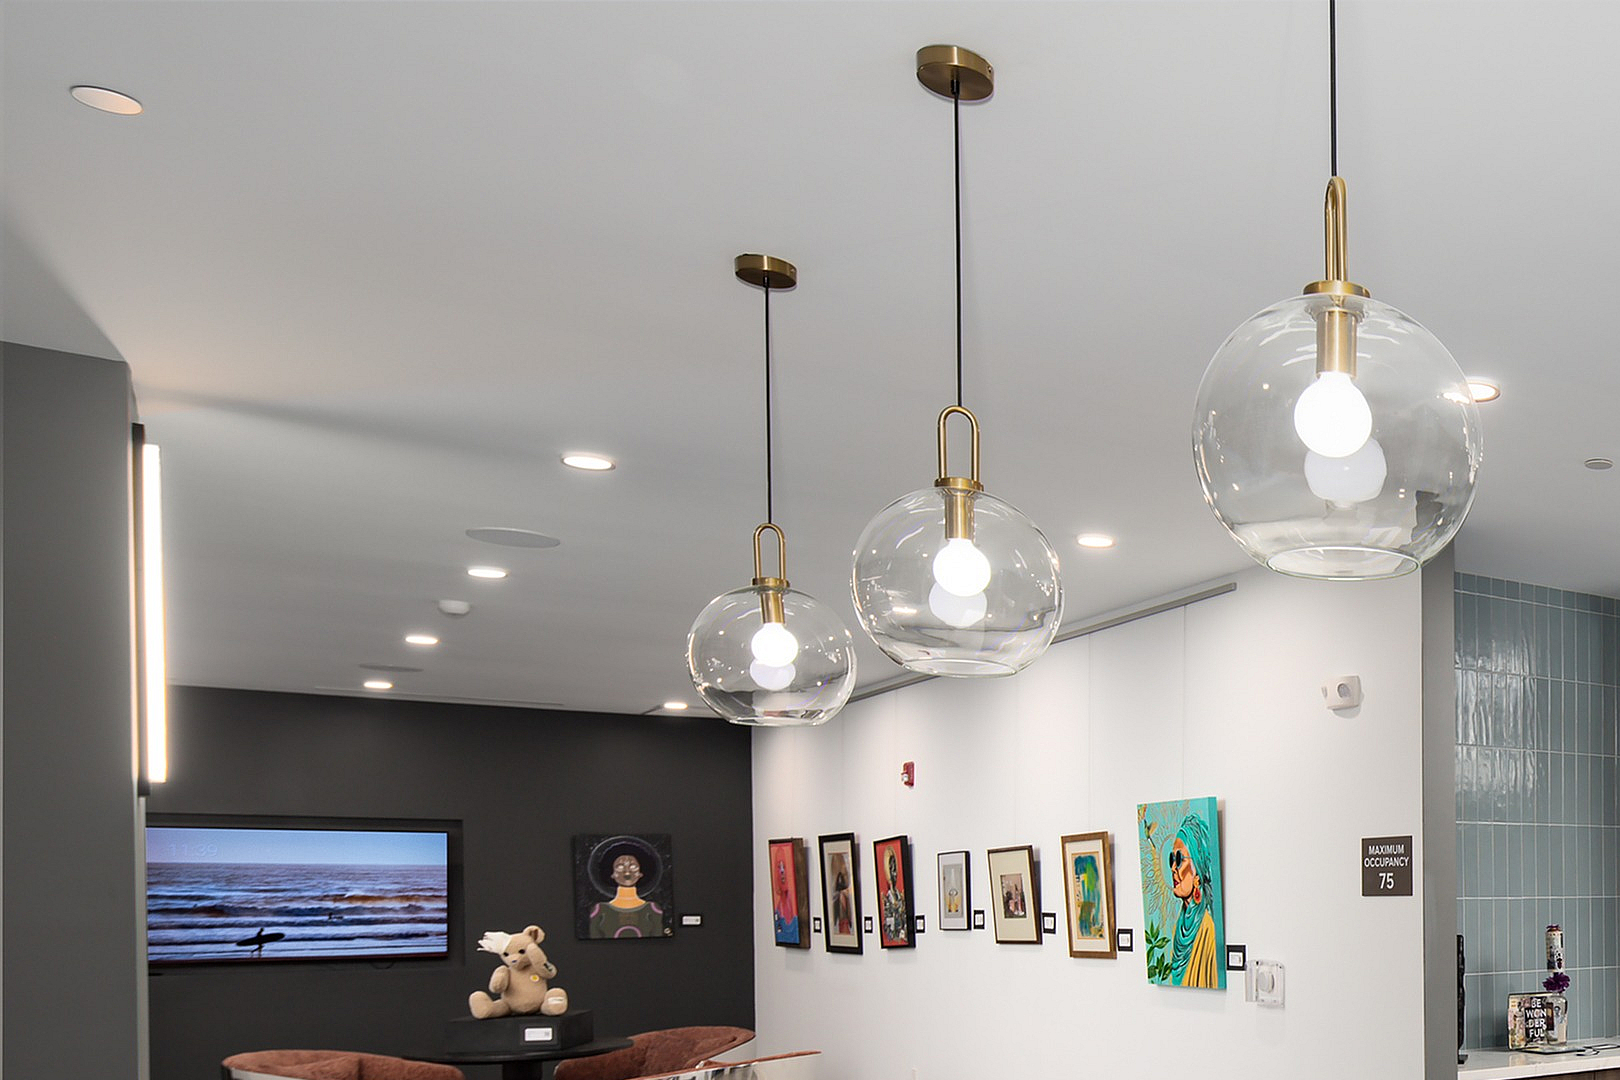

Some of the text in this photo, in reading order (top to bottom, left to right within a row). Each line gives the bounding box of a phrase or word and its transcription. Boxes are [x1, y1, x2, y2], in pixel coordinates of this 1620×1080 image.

[1368, 844, 1405, 855] MAXIMUM
[1364, 856, 1410, 868] OCCUPANCY
[1378, 872, 1395, 889] 75
[1531, 998, 1542, 1008] BE
